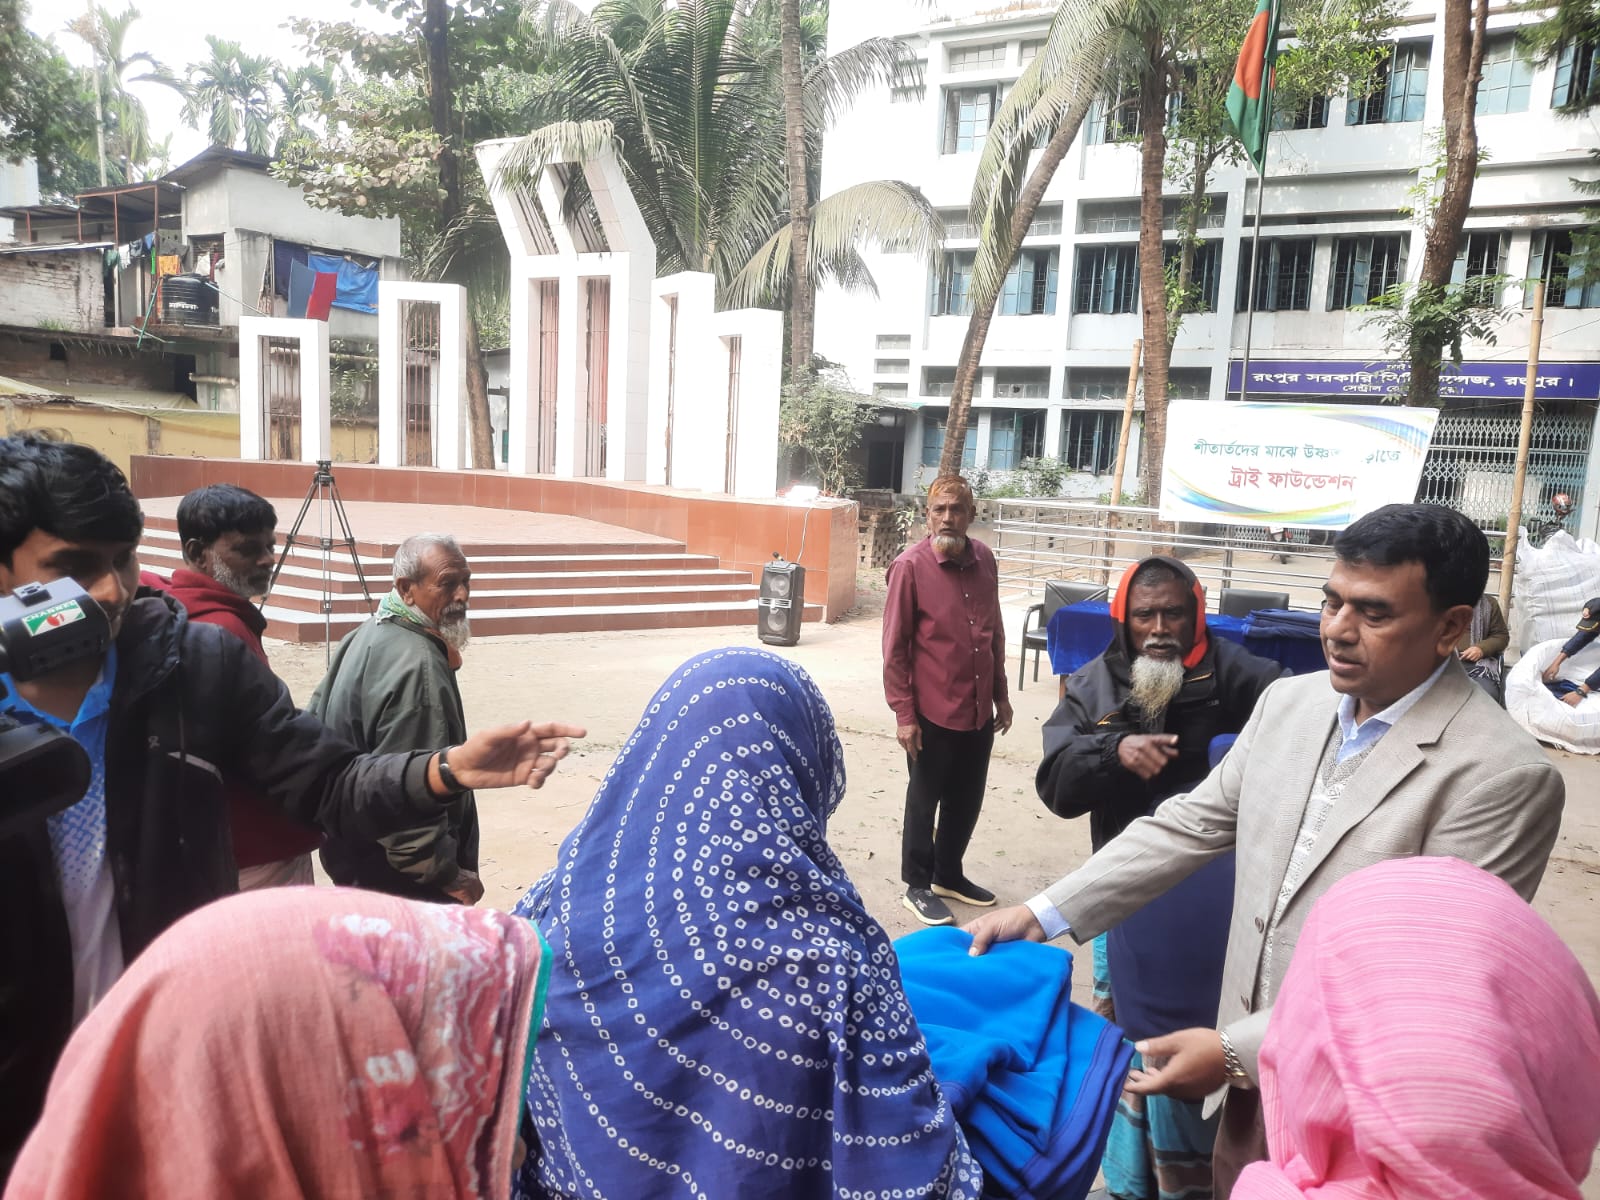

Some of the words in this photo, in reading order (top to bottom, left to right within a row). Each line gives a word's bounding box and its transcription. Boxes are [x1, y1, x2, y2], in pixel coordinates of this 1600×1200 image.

[1252, 372, 1300, 385] রংপুর
[1305, 371, 1374, 384] সরকারি
[1194, 438, 1260, 457] শীতার্তদের
[1265, 445, 1299, 459] মাঝে
[1228, 465, 1263, 489] ট্রাই
[1267, 468, 1358, 492] ফাউন্ডেশন
